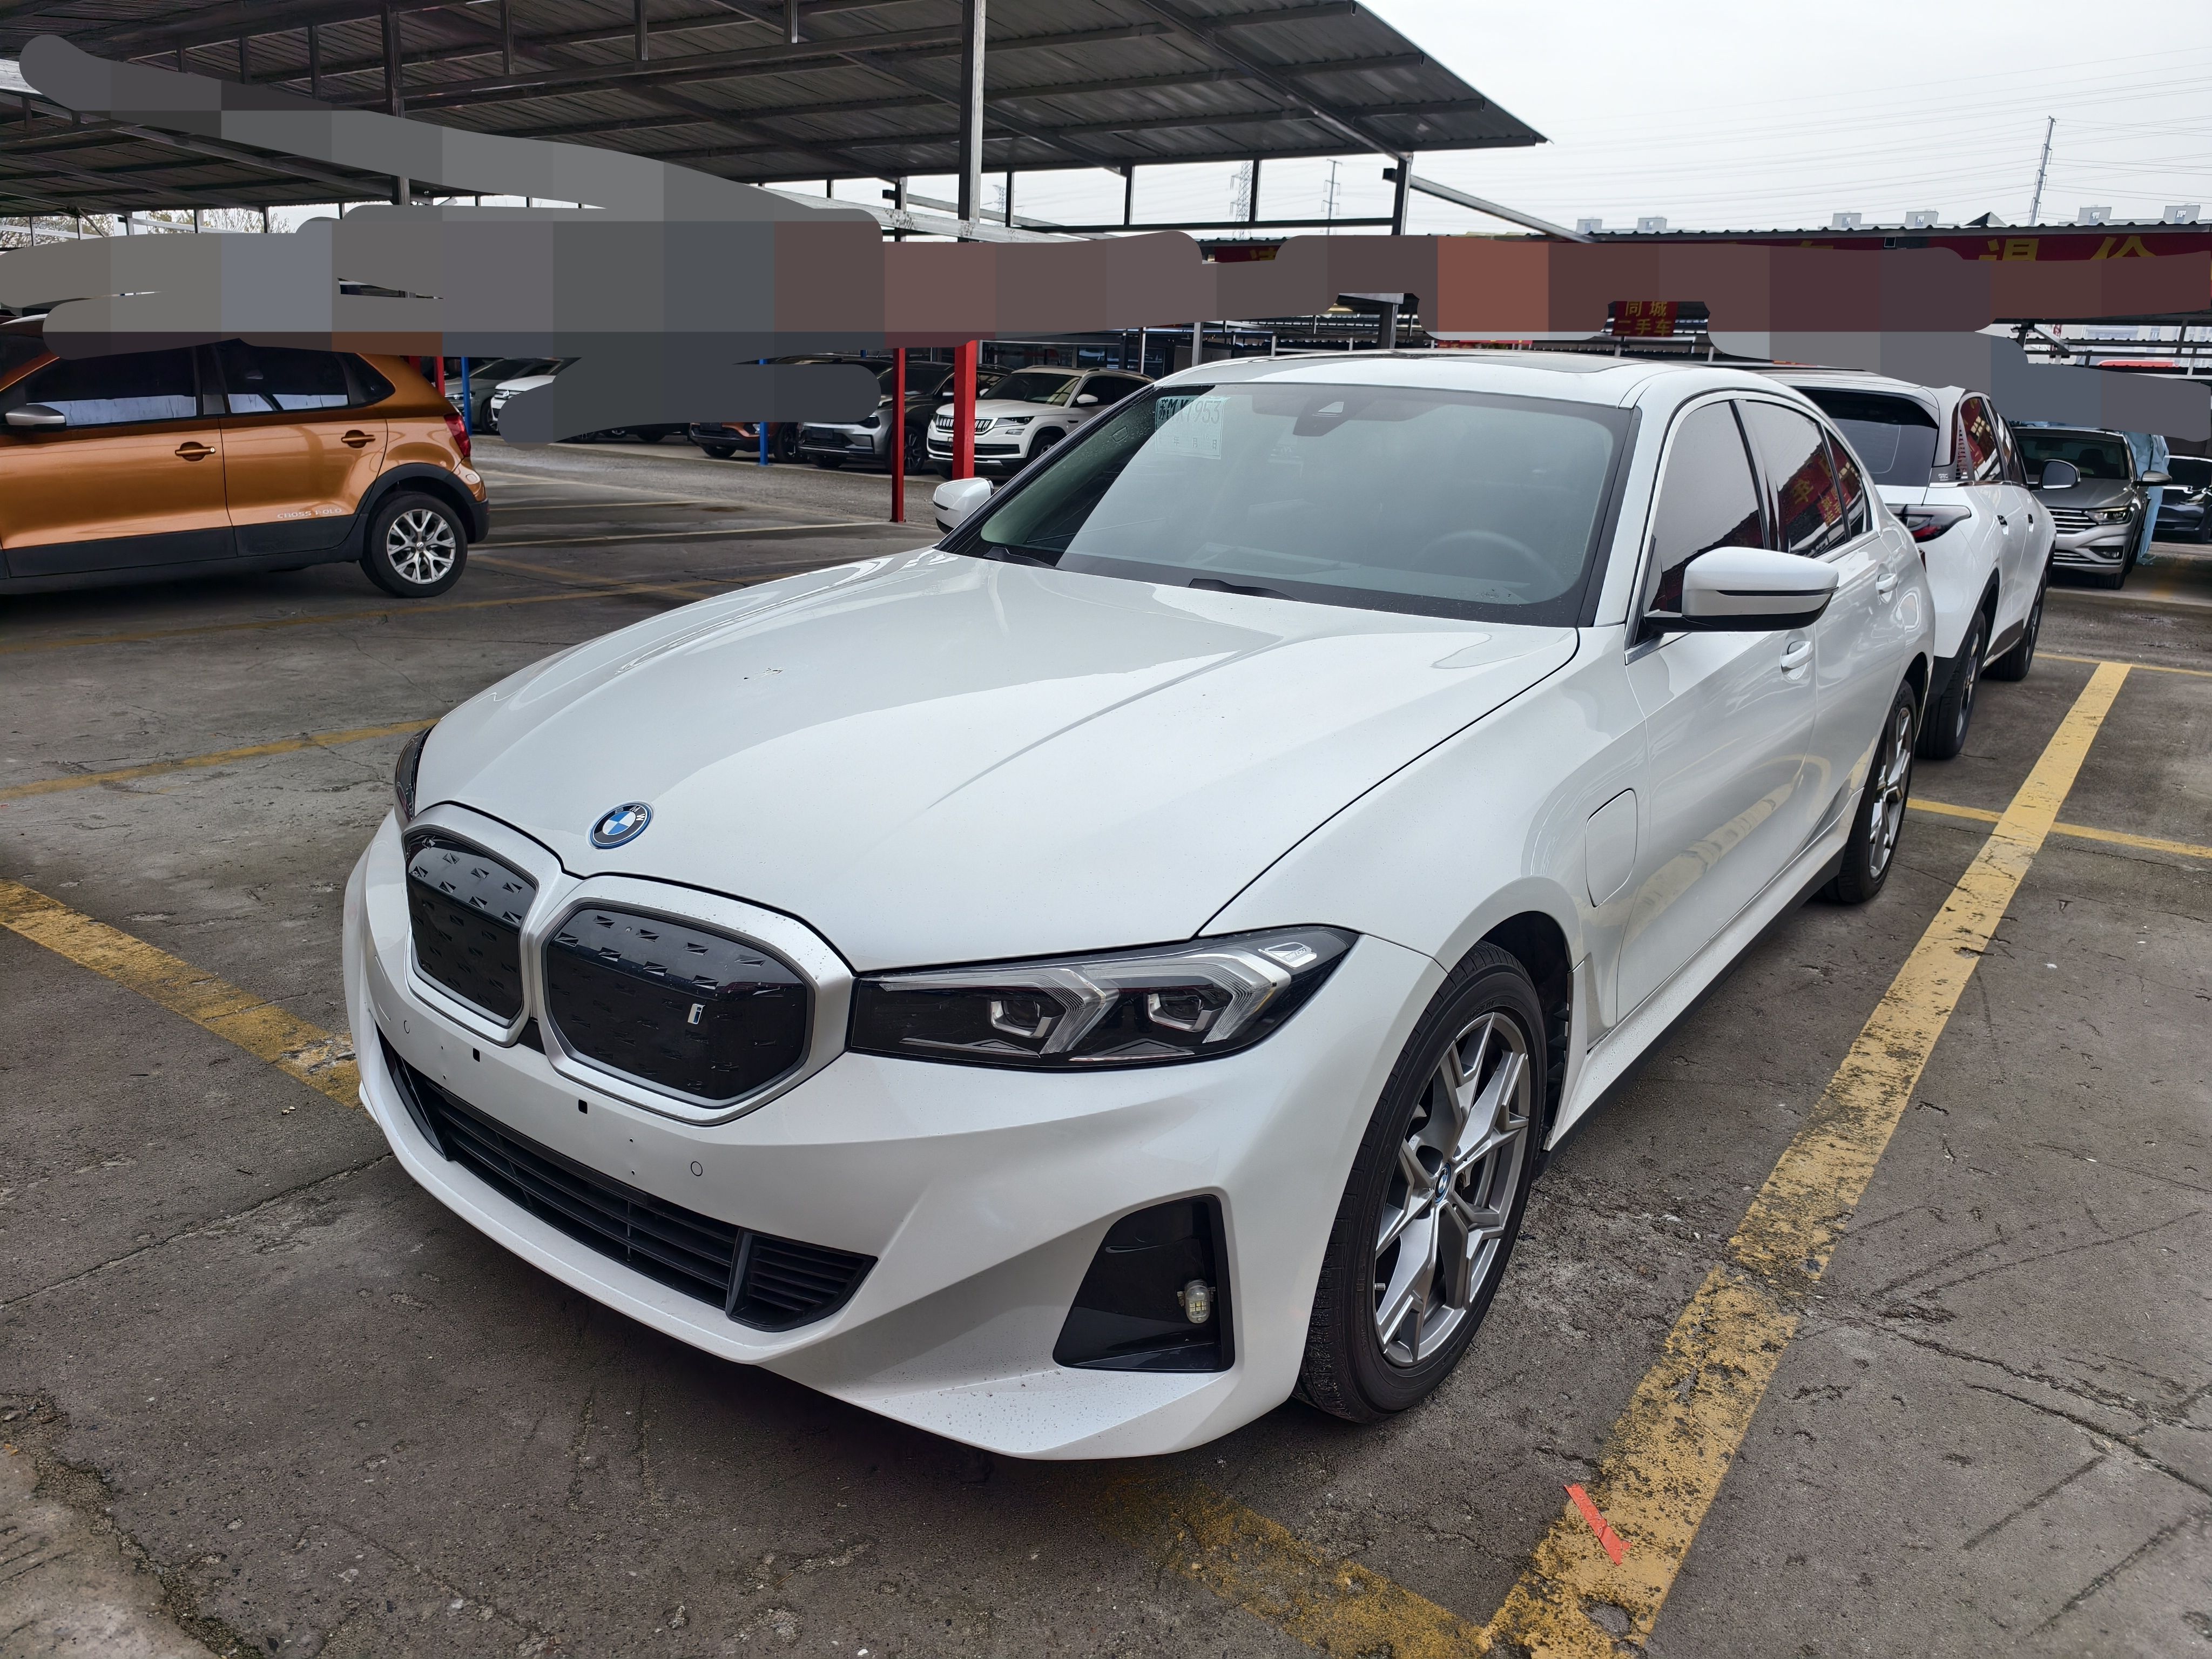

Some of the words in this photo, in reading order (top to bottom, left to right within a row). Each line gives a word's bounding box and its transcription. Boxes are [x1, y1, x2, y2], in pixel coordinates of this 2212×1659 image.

[1625, 301, 1667, 316] 同城
[1614, 318, 1671, 336] 二手车
[277, 510, 312, 518] CROSS
[615, 805, 645, 821] BMW
